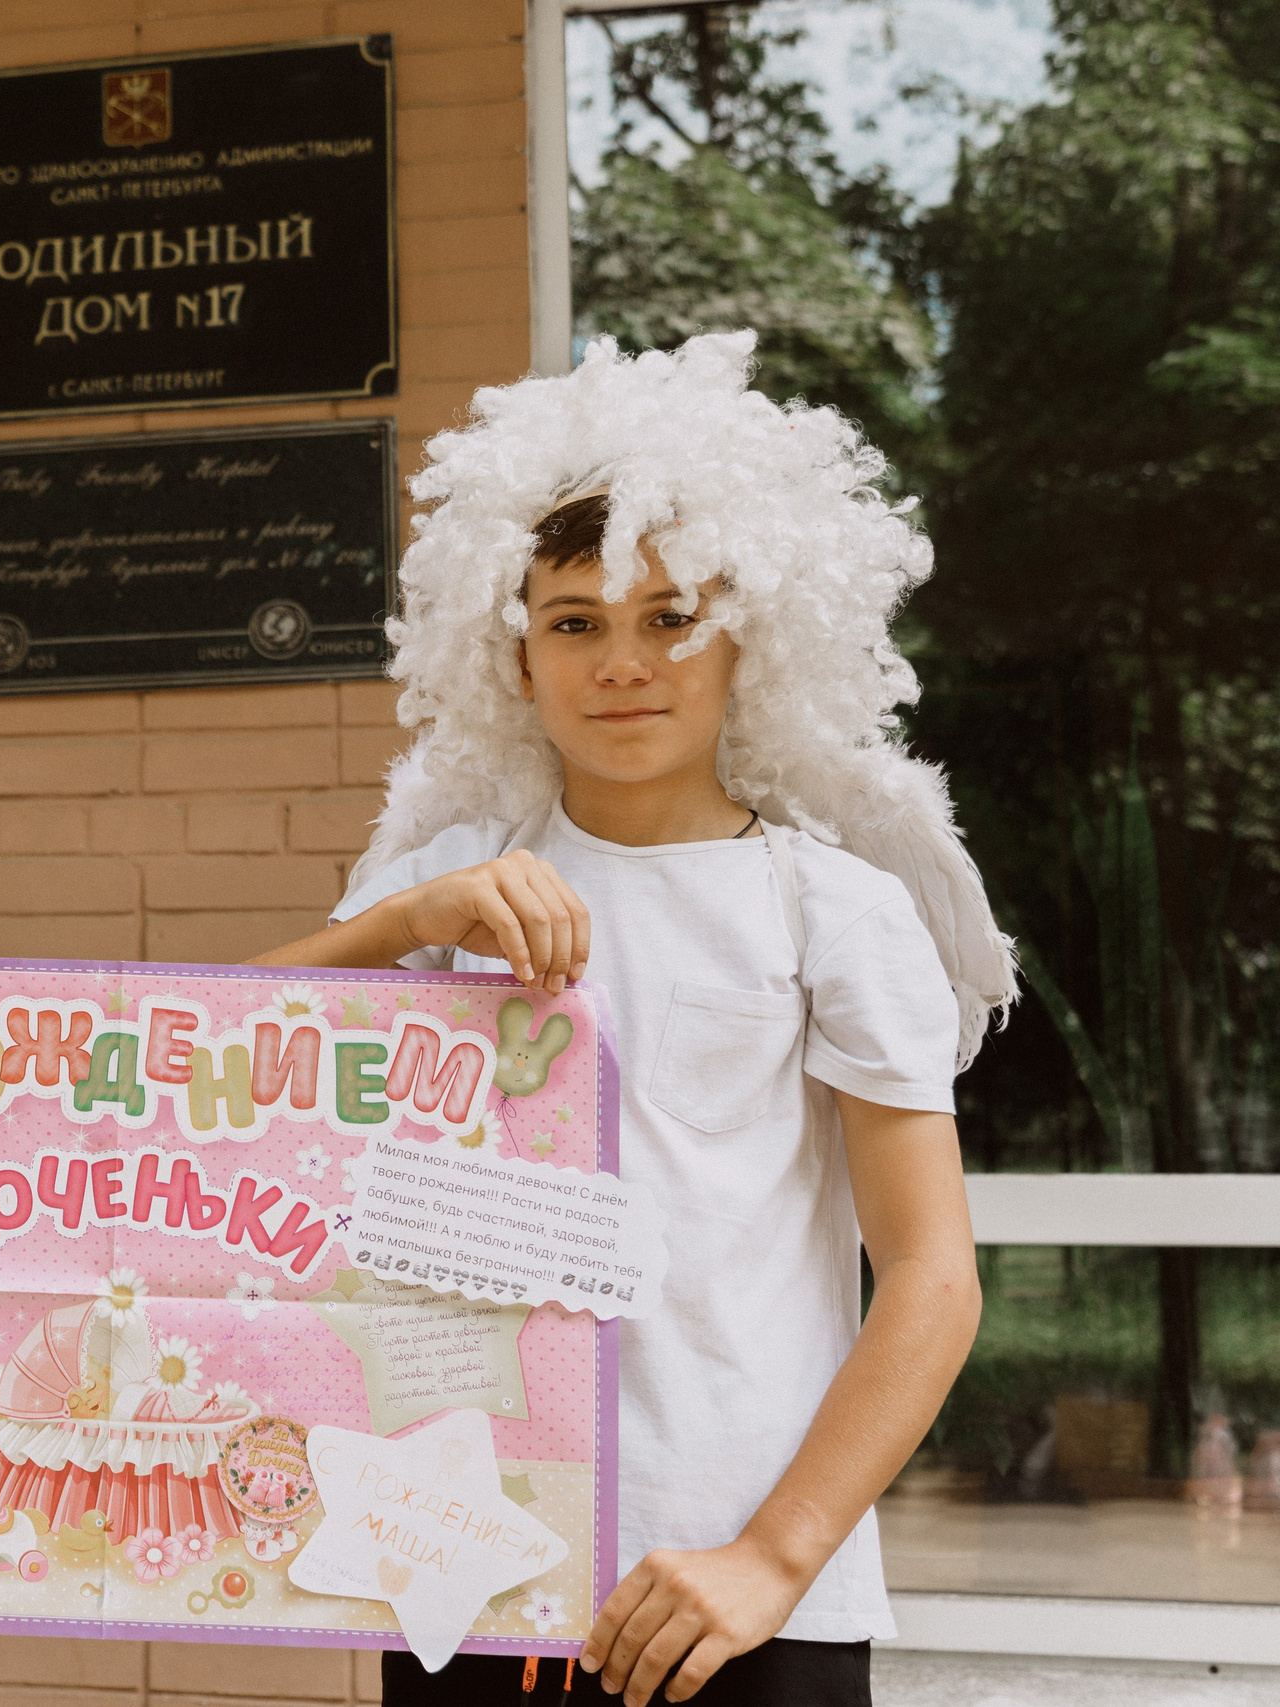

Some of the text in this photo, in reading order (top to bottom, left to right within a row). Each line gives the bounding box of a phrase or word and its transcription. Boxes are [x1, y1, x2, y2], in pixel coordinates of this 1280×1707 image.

[34, 291, 150, 346] ДОМ
[372, 1165, 619, 1230] твоего рождения!!! Расти на радость
[376, 1142, 628, 1208] Милая моя любимая девочка! С днём
[362, 1208, 643, 1280] любимой!!! А я люблю и буду любить тебя
[367, 1185, 618, 1252] бабушке, будь счастливой, здоровой,
[358, 1230, 555, 1283] моя малышка безгранично!!!
[358, 1304, 502, 1332] на свете лучше милой дочки!
[449, 1293, 462, 1302] не
[367, 1330, 409, 1355] Пусть
[452, 1324, 500, 1346] девчушка
[442, 1373, 503, 1396] счастливой!
[243, 1435, 308, 1463] Рождени
[270, 1425, 290, 1441] За
[247, 1449, 305, 1477] Дочки
[317, 1446, 549, 1570] С РОЖДЕНИЕМ
[350, 1511, 461, 1577] МАША!
